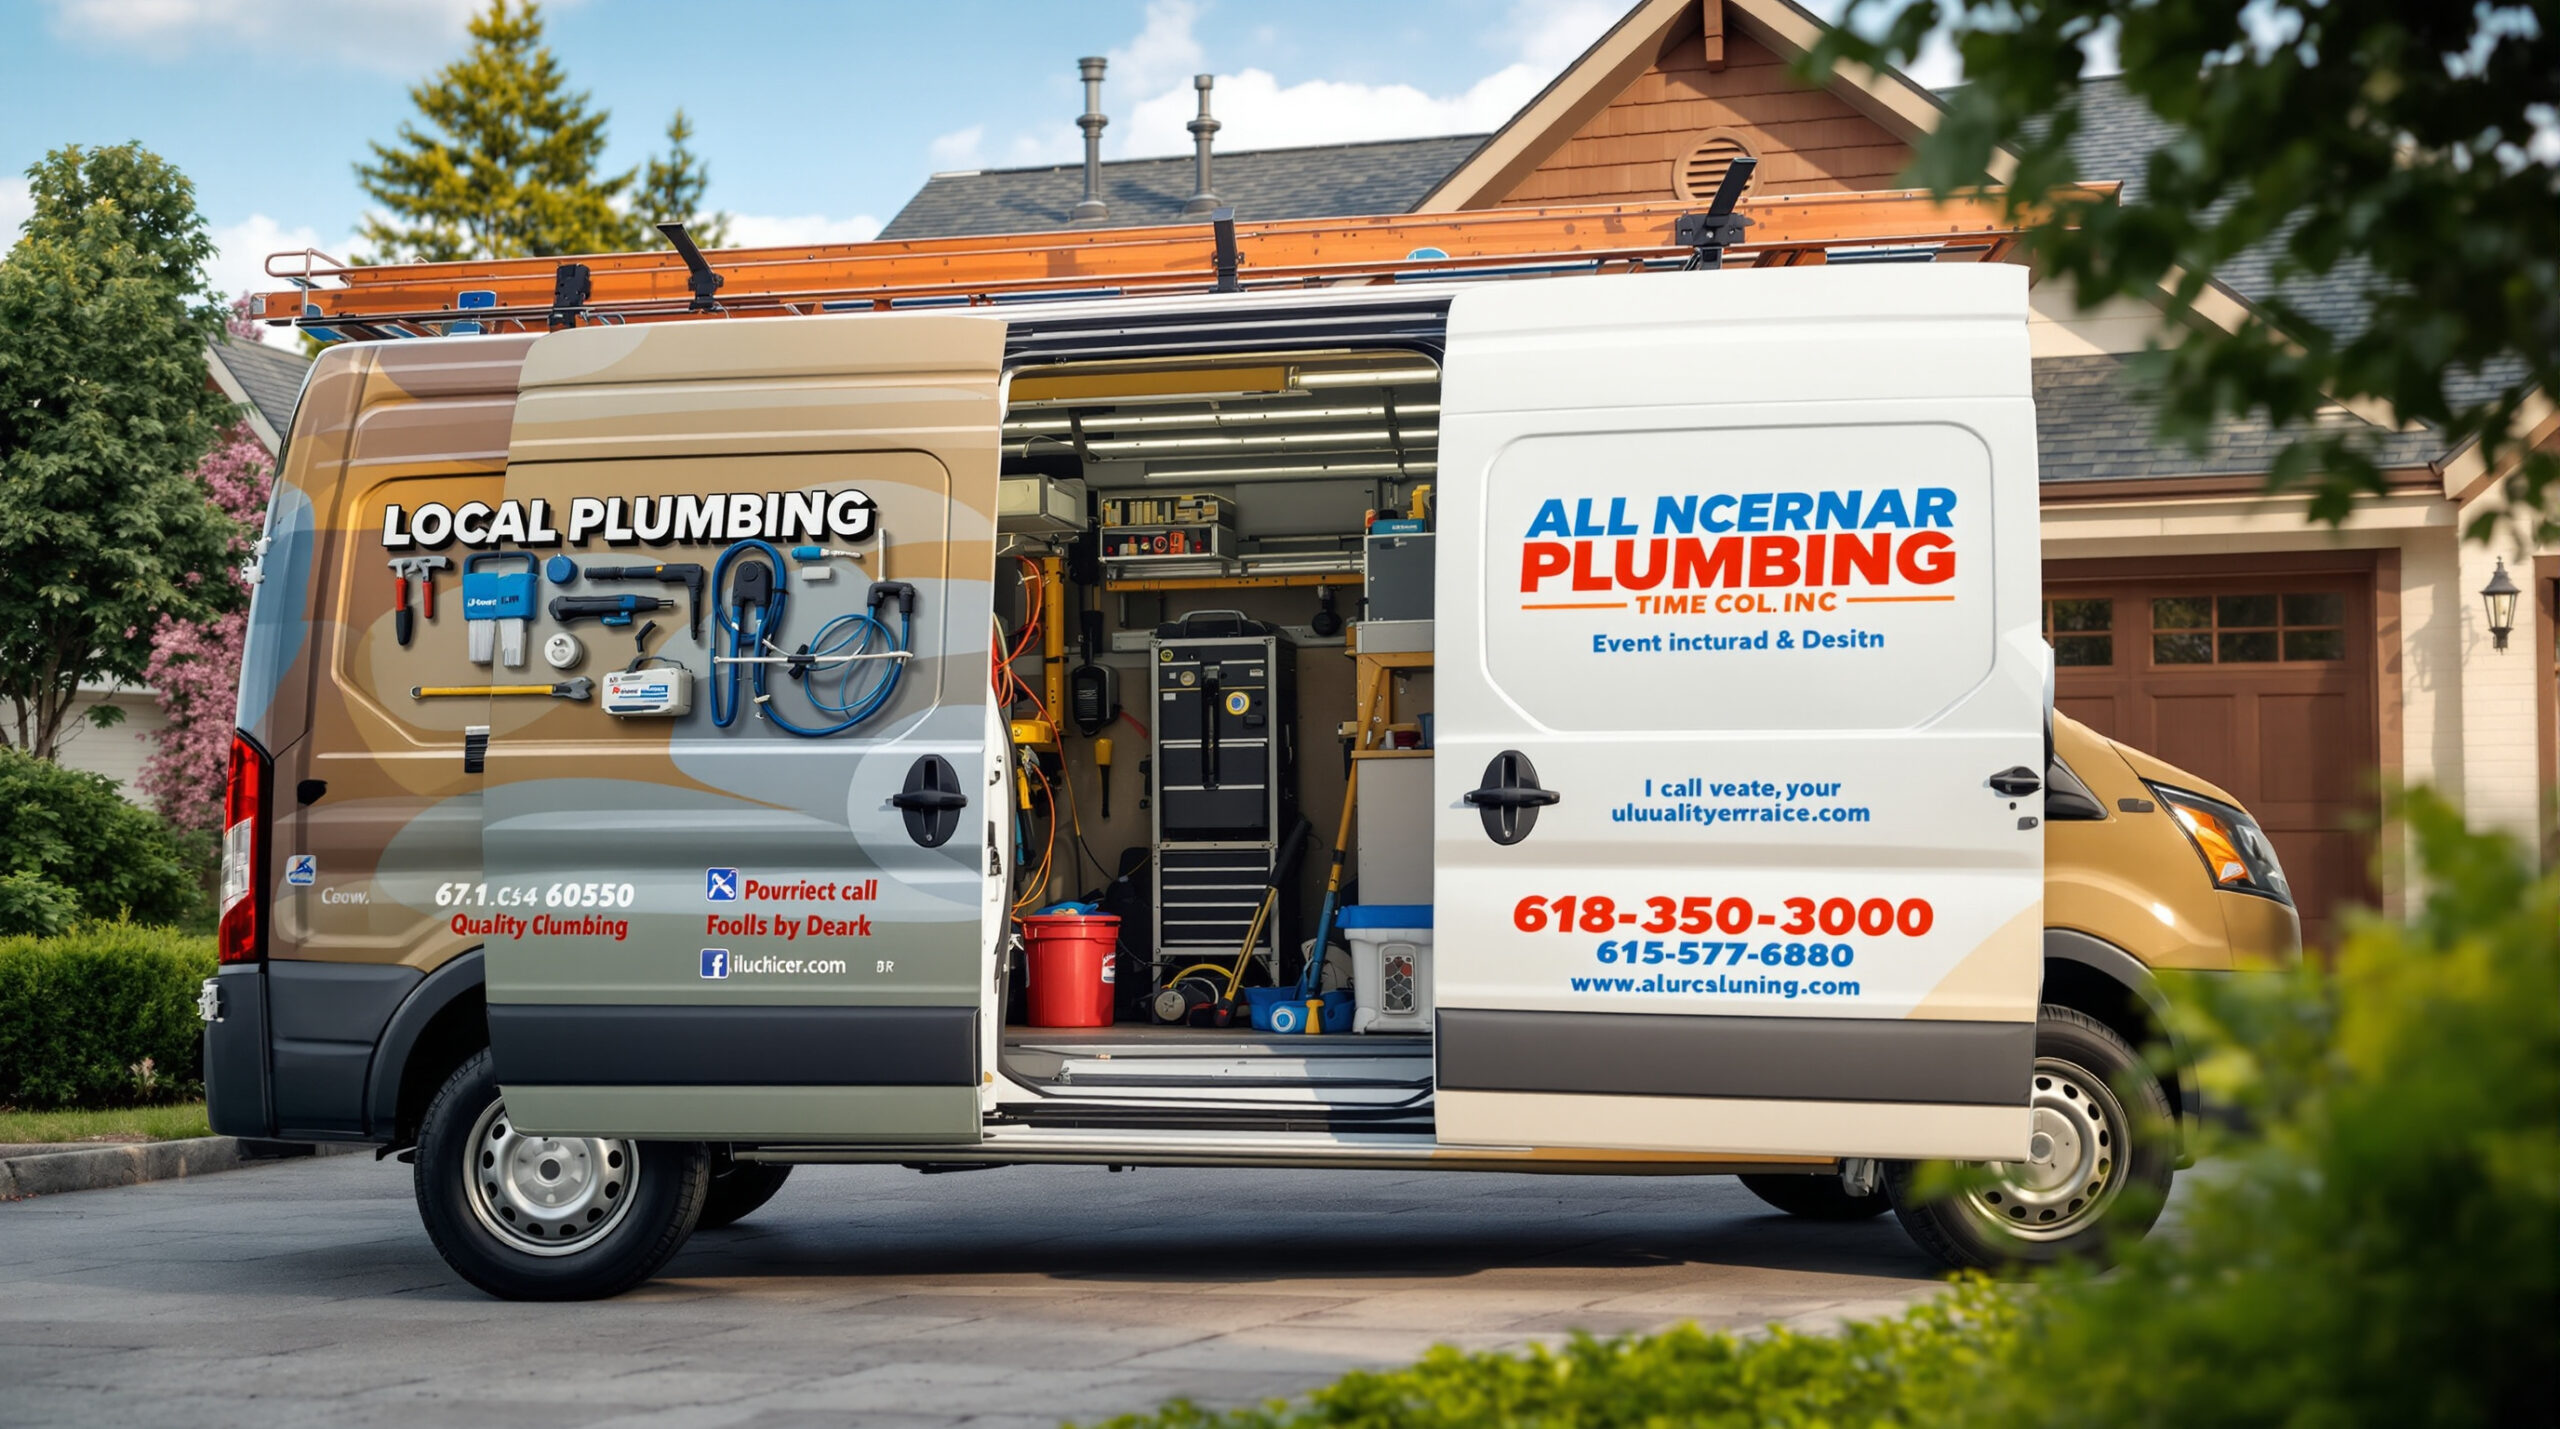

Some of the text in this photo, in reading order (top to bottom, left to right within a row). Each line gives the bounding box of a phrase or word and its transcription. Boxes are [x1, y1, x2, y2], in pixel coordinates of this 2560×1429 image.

[381, 488, 877, 549] LOCAL PLUMBING
[1524, 487, 1957, 538] ALL NCERNAR
[1520, 531, 1956, 592] PLUMBING
[1635, 592, 1838, 614] TIME COL. INC
[1593, 629, 1885, 653] Event incturad & Desitn
[1660, 778, 1702, 797] call
[1710, 780, 1781, 799] veate,
[1786, 782, 1841, 801] your
[545, 883, 635, 907] 60550
[841, 879, 878, 901] call
[450, 913, 628, 941] Quality Clumbing
[706, 914, 872, 940] Foolls by Deark
[1513, 895, 1934, 938] 618-350-3000
[1597, 940, 1855, 967] 615-577-6880
